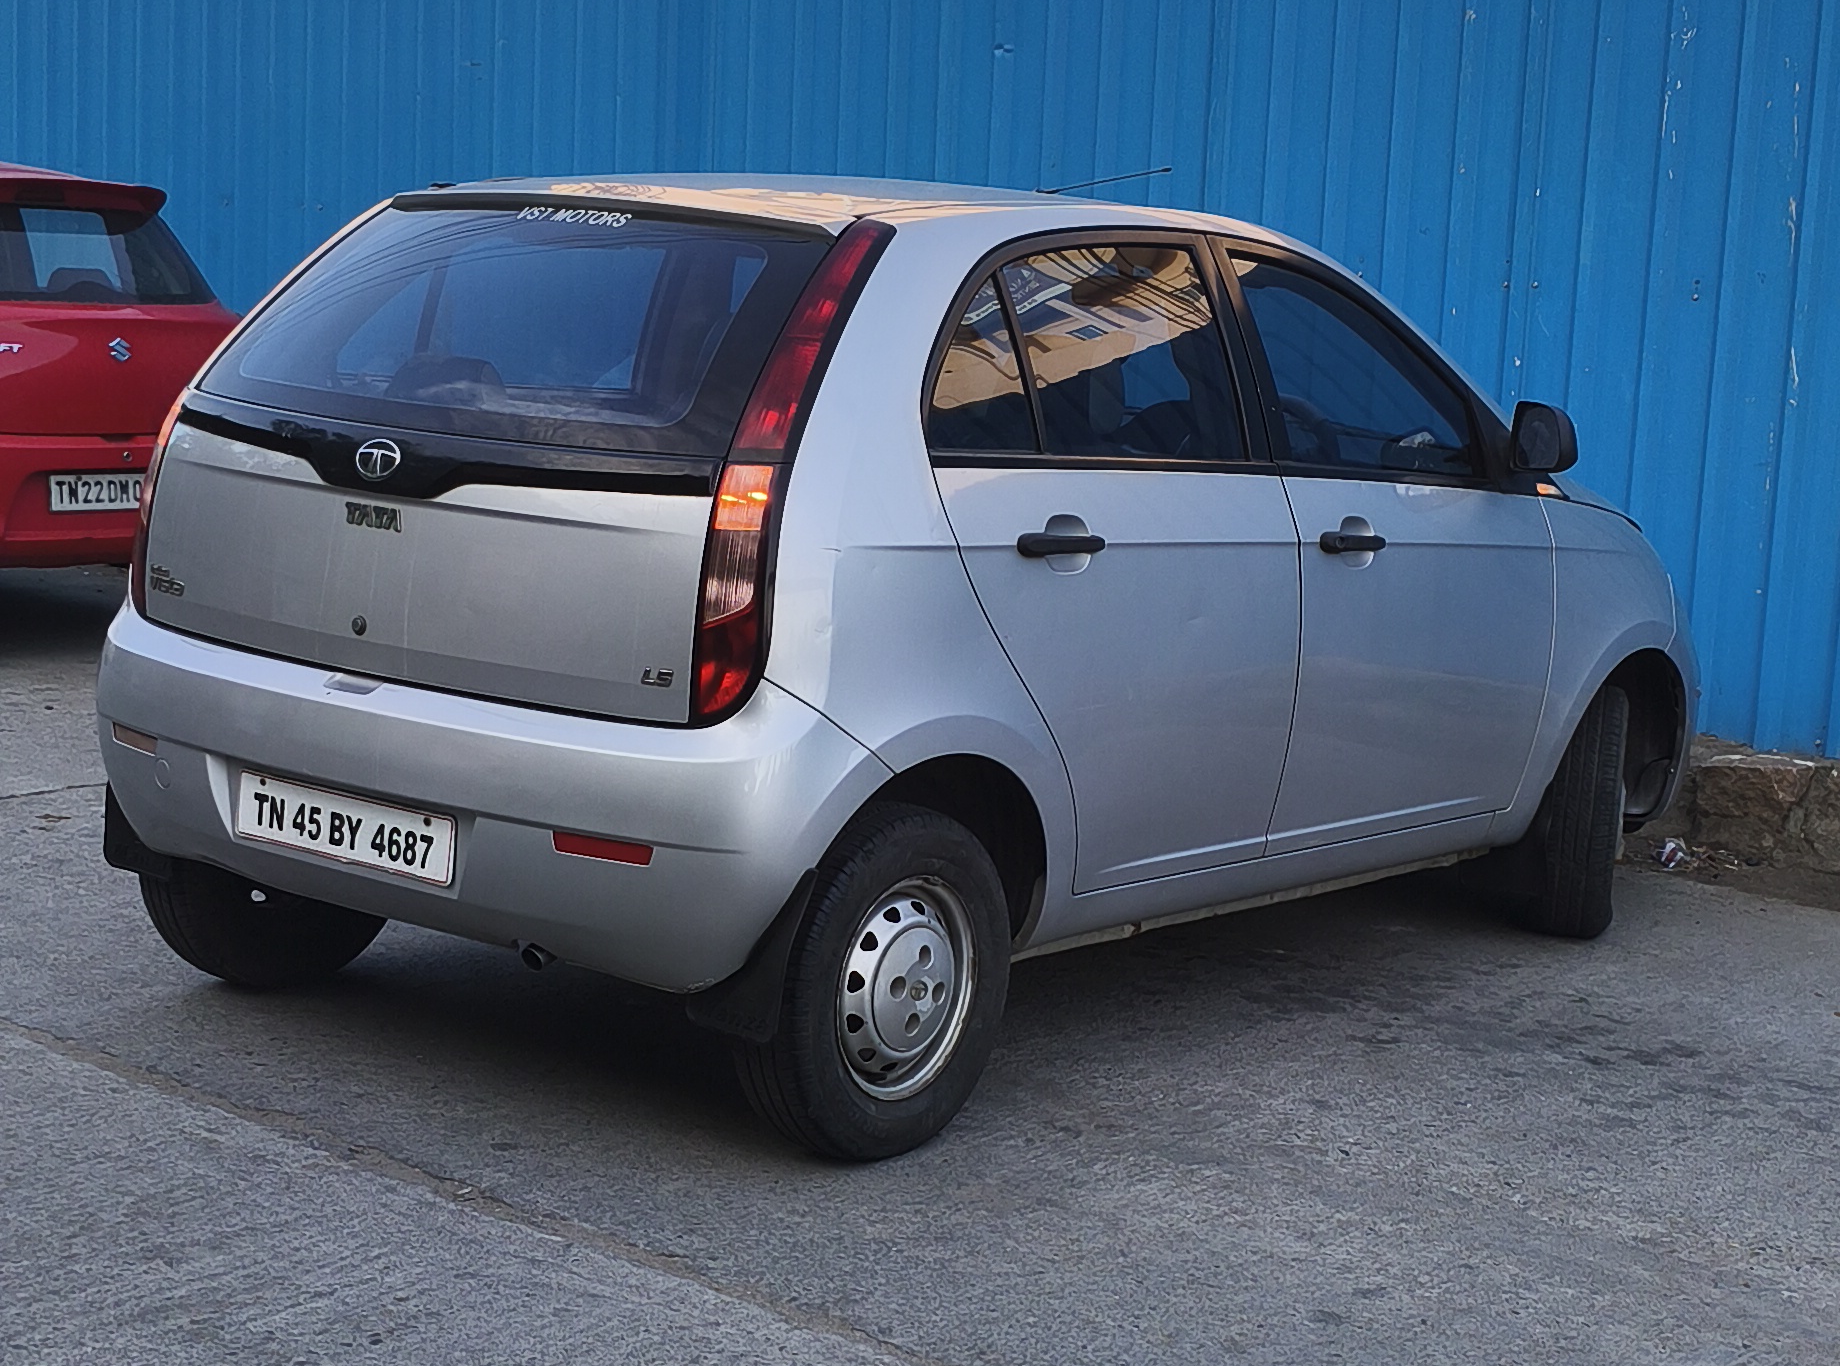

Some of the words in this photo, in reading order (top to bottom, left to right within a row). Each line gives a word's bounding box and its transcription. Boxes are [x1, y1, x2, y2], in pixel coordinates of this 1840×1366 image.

[516, 206, 553, 221] VST
[550, 208, 633, 229] MOTORS
[345, 501, 402, 533] TATA
[641, 666, 674, 688] LS
[254, 791, 286, 832] TN
[292, 802, 322, 841] 45
[328, 810, 363, 851] BY
[370, 823, 435, 870] 4687
